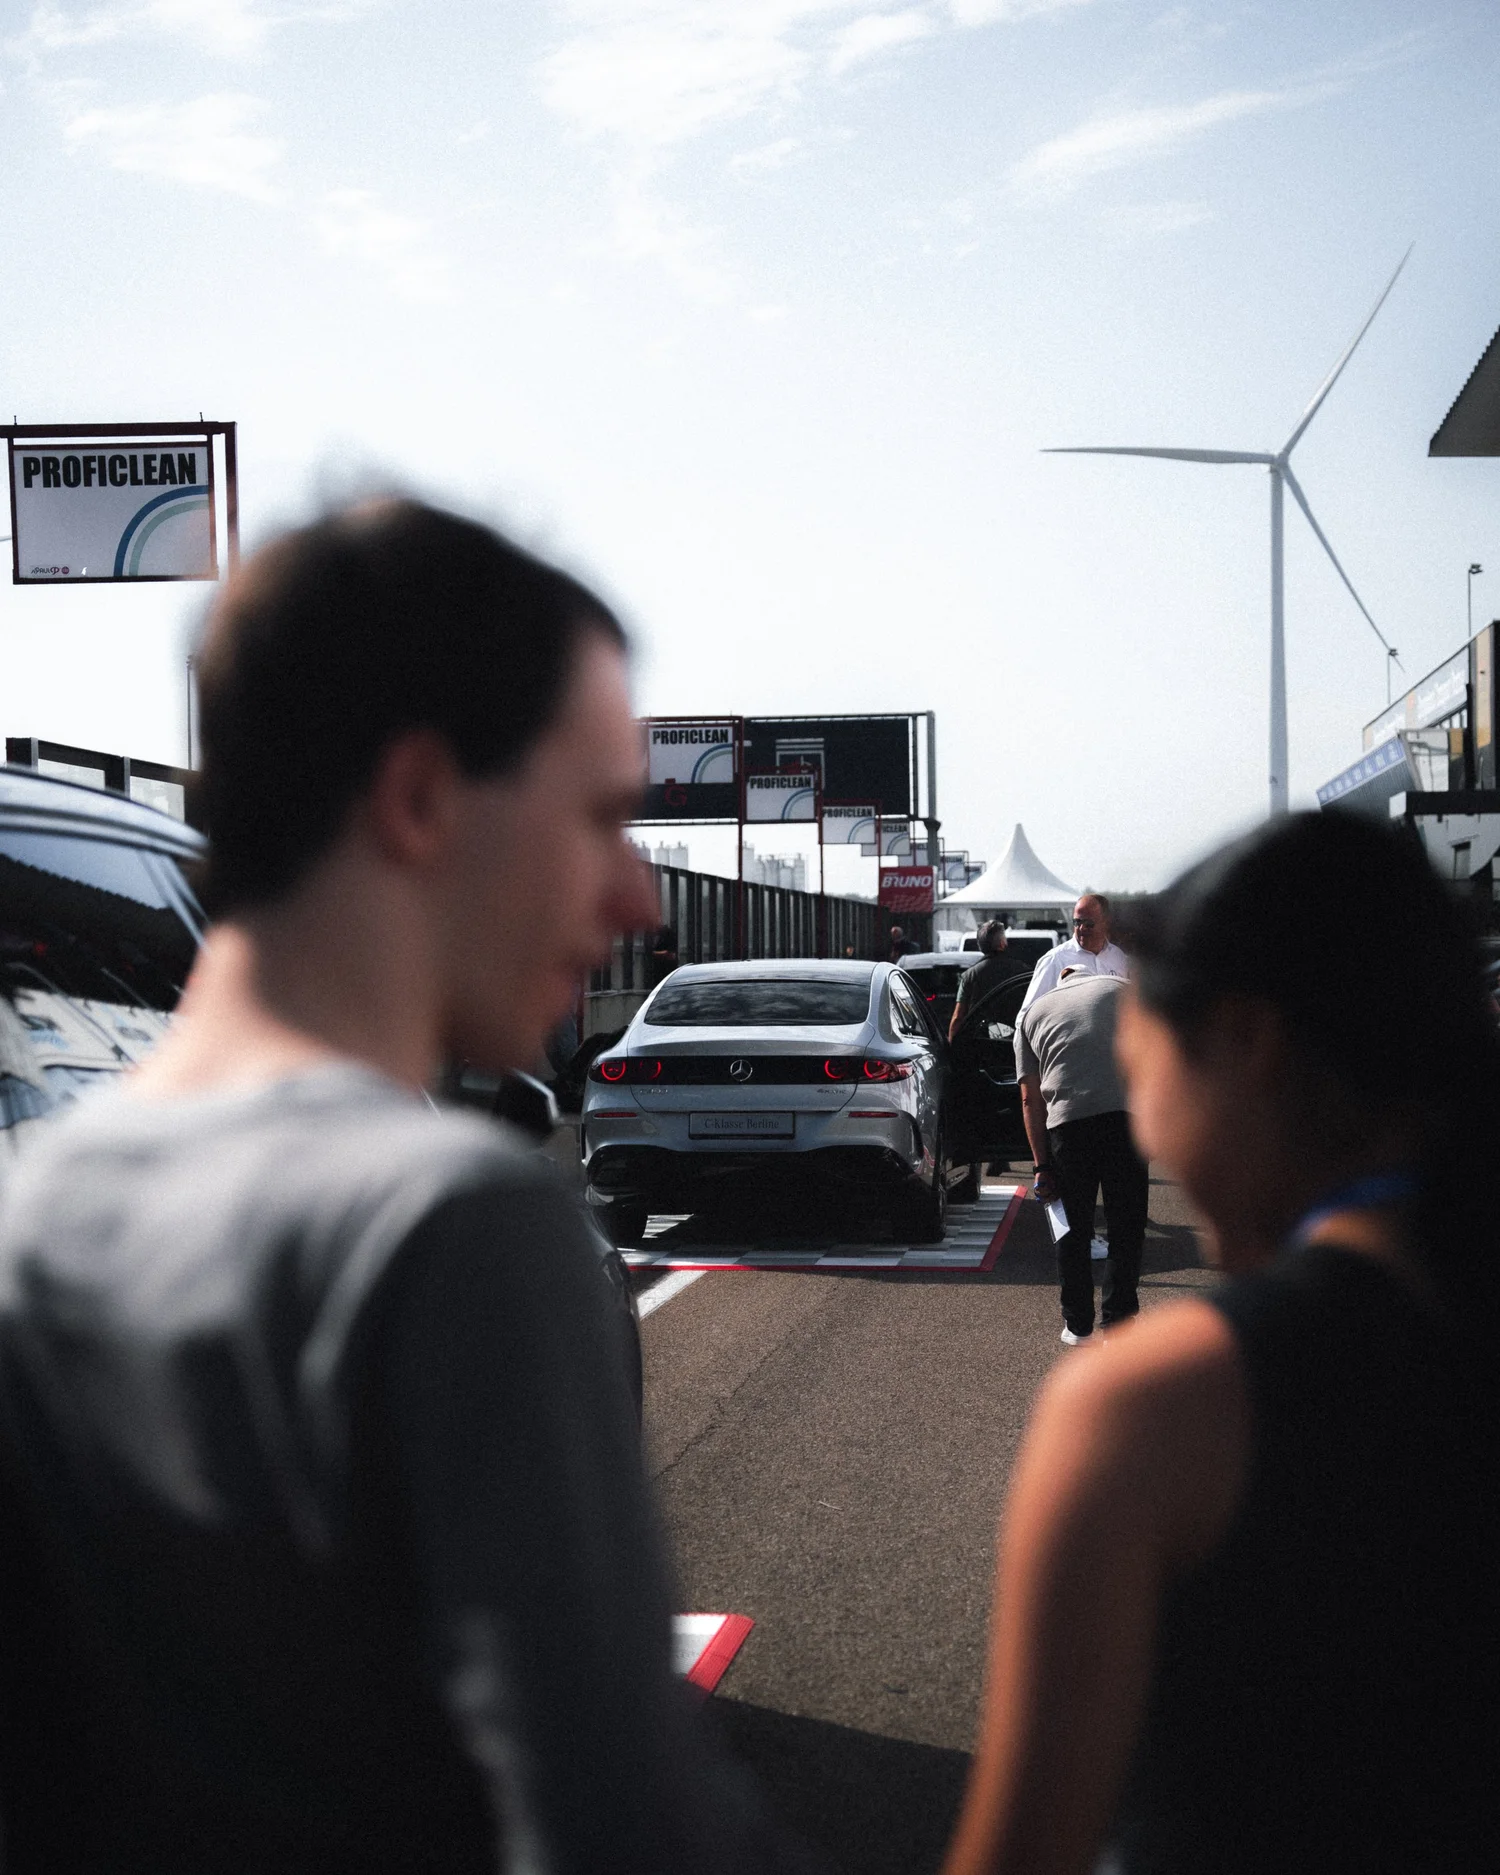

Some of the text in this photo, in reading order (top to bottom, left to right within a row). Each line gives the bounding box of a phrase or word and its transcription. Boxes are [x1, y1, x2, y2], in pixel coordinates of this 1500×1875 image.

[23, 453, 196, 488] PROFICLEAN
[652, 729, 729, 744] PROFICLEAN
[750, 776, 811, 789] PROFICLEAN
[881, 875, 932, 888] BRUNO
[704, 1118, 780, 1129] C-Klasse Berline
